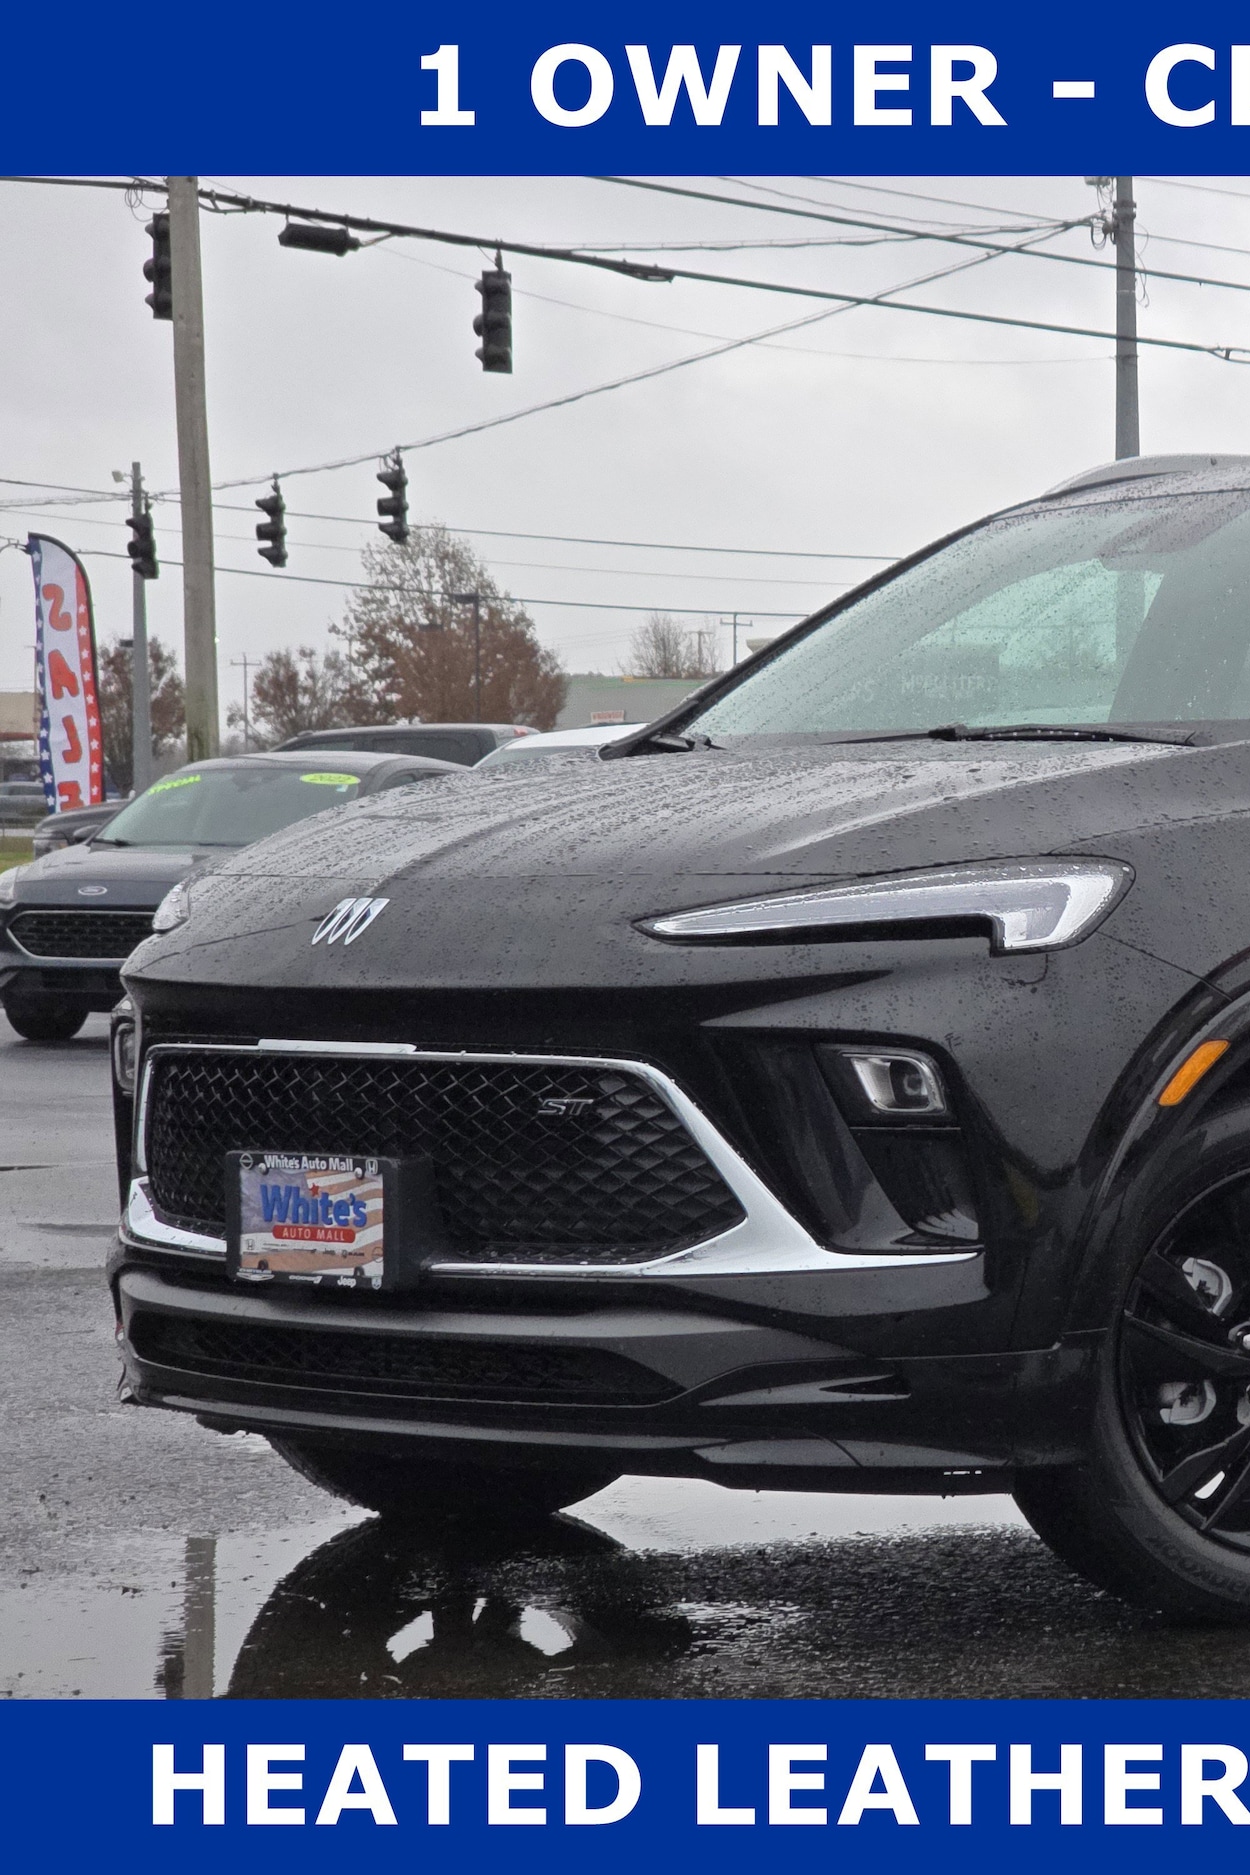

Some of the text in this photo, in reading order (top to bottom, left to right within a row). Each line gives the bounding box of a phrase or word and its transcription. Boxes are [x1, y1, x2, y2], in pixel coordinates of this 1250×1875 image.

[537, 1098, 594, 1116] ST
[263, 1154, 354, 1172] White's Auto Mall
[260, 1183, 368, 1229] White's
[282, 1227, 345, 1241] AUTO MALL
[337, 1275, 357, 1288] Jeep
